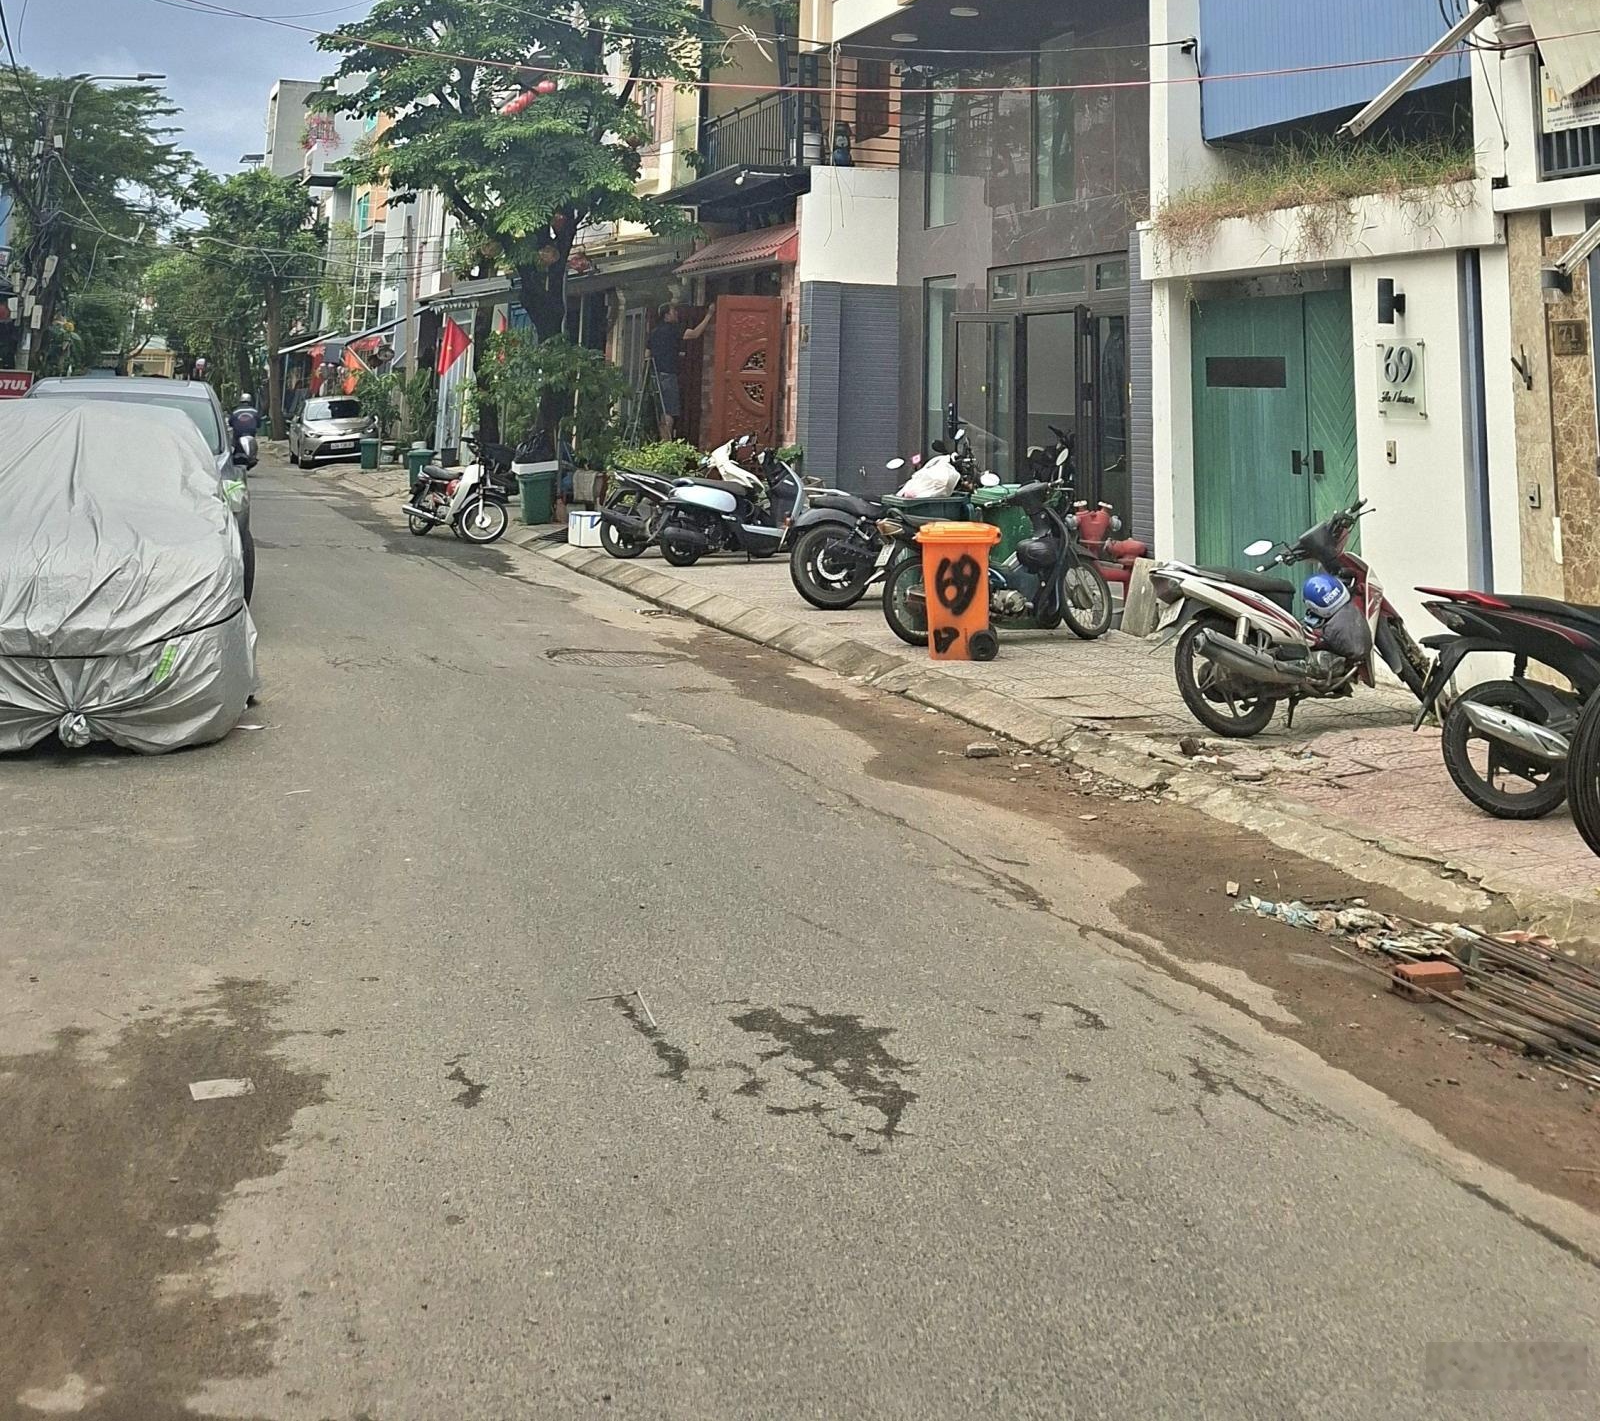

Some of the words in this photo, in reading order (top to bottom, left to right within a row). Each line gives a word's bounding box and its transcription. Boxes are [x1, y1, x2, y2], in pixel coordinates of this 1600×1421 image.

[1559, 325, 1578, 341] 71
[1384, 346, 1414, 383] 69
[935, 554, 981, 615] 69
